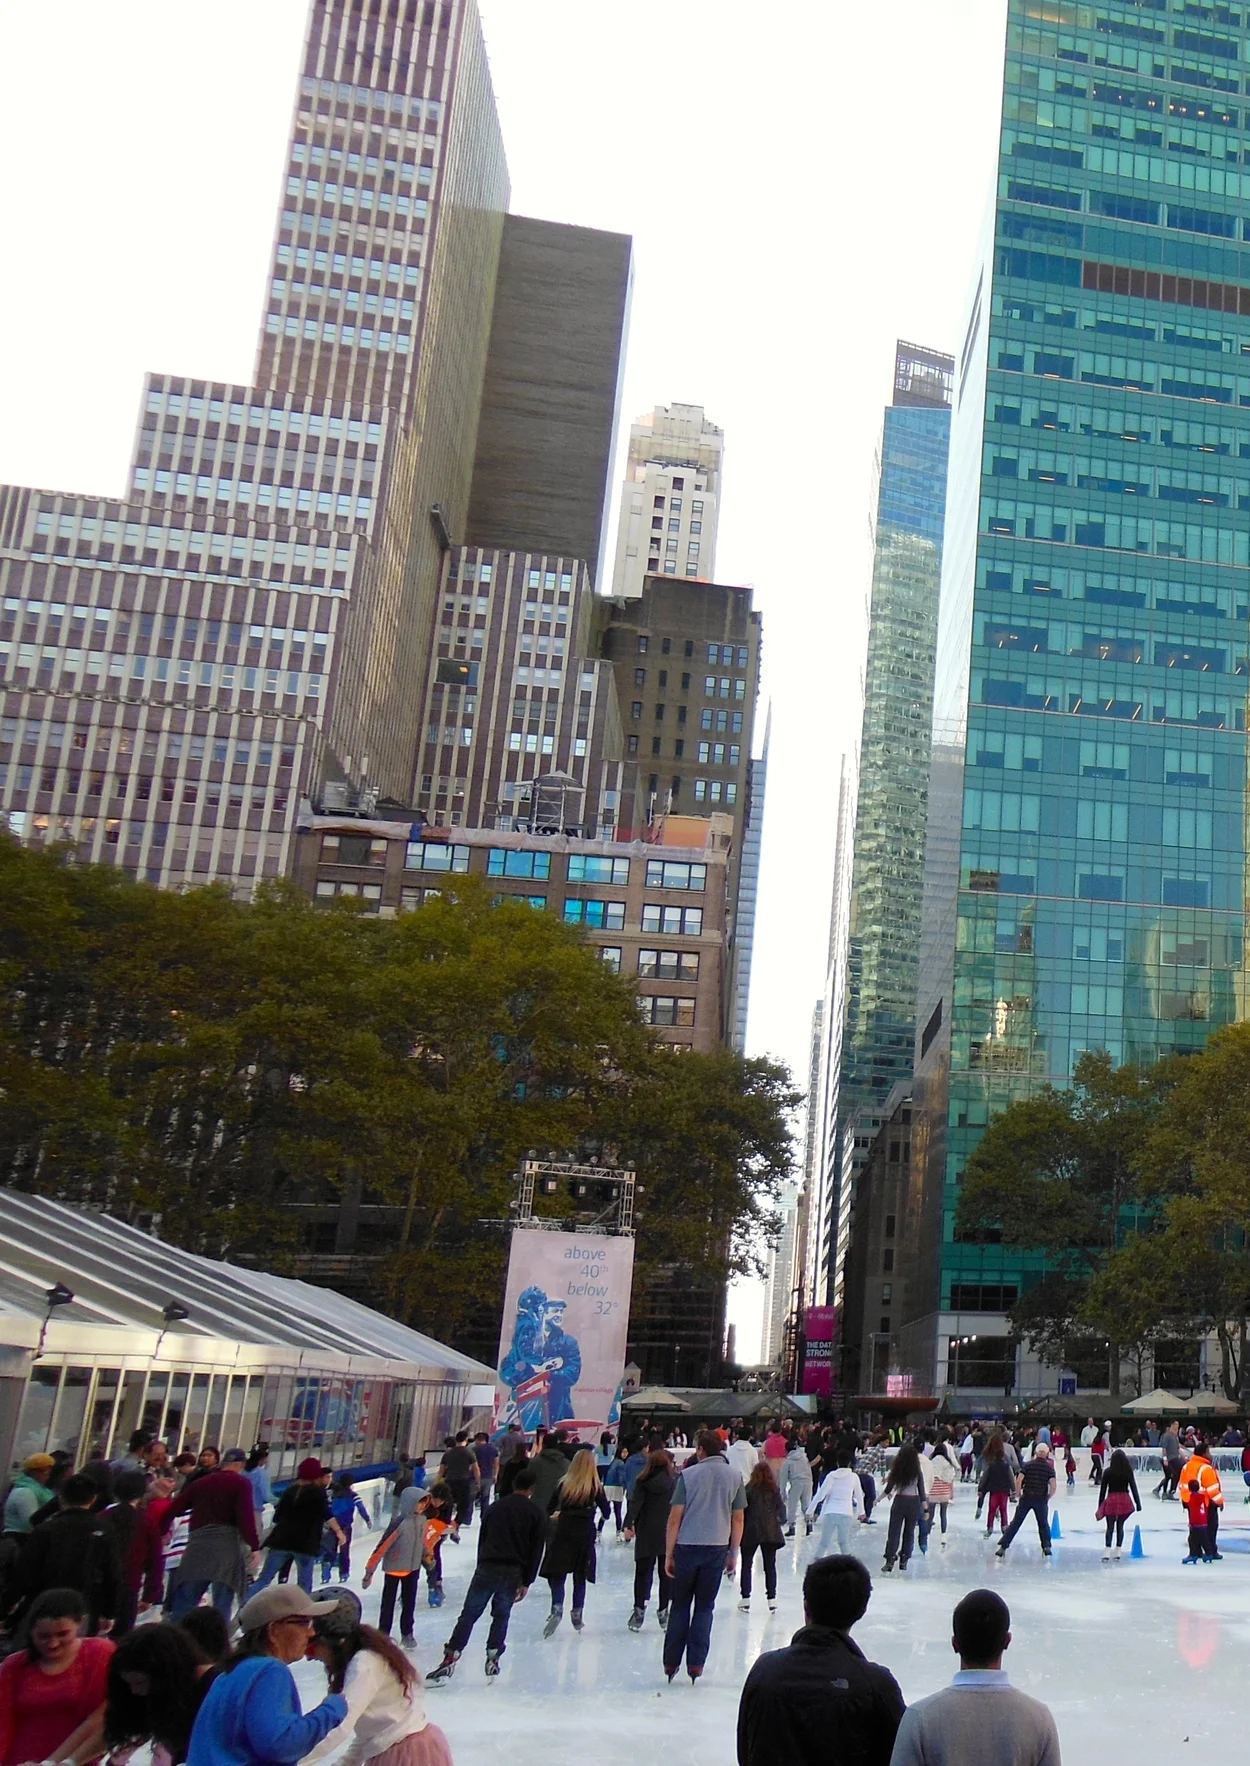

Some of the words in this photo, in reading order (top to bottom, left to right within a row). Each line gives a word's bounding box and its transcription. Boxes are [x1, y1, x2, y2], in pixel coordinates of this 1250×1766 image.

[564, 1245, 606, 1261] above
[580, 1264, 609, 1278] 40th
[567, 1281, 609, 1297] below
[806, 1341, 819, 1349] THE
[819, 1341, 833, 1349] DAT
[804, 1360, 832, 1368] NETWOR
